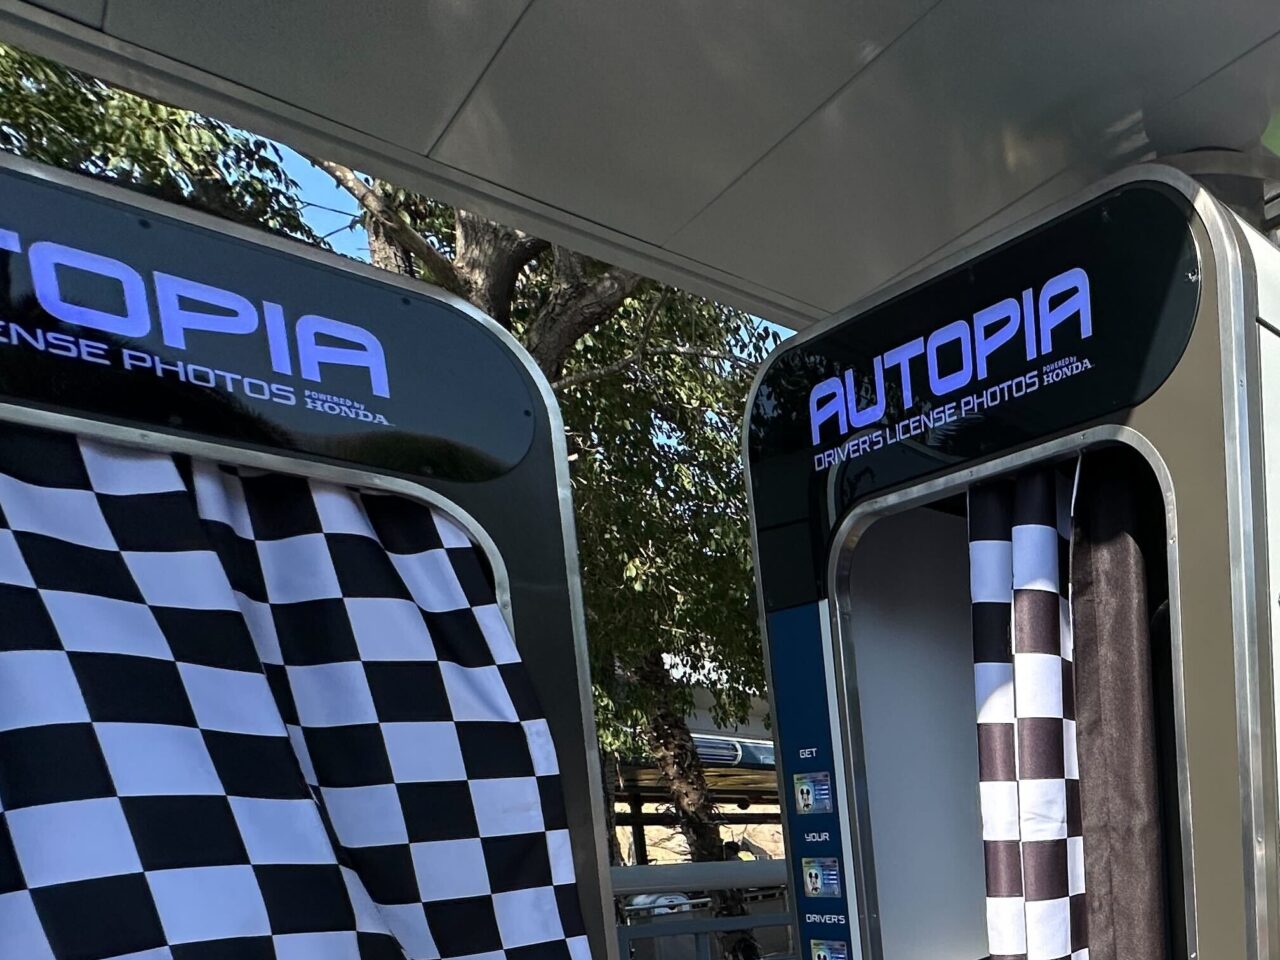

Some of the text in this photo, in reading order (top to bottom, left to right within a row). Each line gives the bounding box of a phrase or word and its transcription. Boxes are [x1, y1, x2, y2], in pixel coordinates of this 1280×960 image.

[0, 228, 391, 399] OPIA
[809, 267, 1093, 446] AUTOPIA
[122, 348, 297, 406] PHOTOS
[1042, 358, 1093, 386] HONDA
[303, 397, 392, 426] HONDA
[304, 389, 353, 407] POWERED
[814, 370, 1039, 472] DRIVER'S LICENSE PHOTOS
[799, 747, 818, 759] GET
[804, 832, 830, 842] YOUR
[805, 913, 846, 924] DRIVER'S
